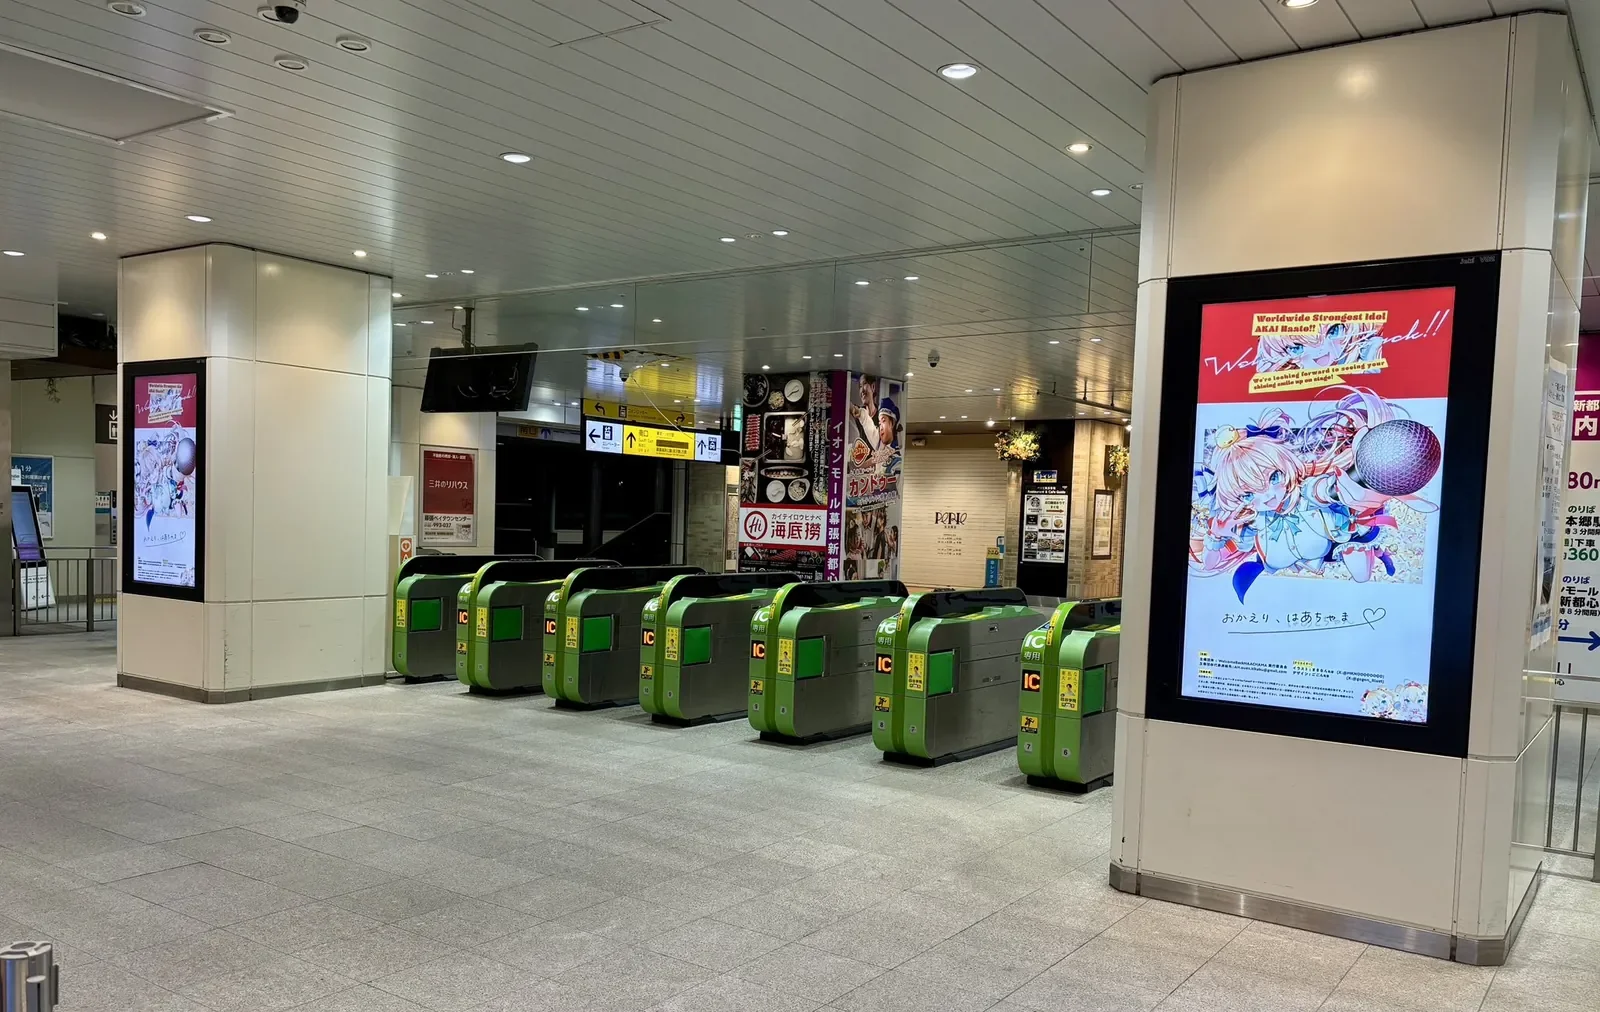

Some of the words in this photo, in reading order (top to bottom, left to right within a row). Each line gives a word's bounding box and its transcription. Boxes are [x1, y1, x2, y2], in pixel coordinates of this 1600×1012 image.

[1256, 314, 1310, 322] Worldwide
[1312, 312, 1363, 322] Strongest
[1365, 312, 1386, 320] Idol
[1280, 324, 1316, 332] Haato!!
[1253, 376, 1272, 384] We're
[1273, 372, 1300, 380] looking
[1301, 368, 1330, 376] forward
[1341, 362, 1366, 372] seeing
[1367, 361, 1386, 370] your
[1254, 382, 1276, 390] shining
[1314, 374, 1334, 382] stage!
[1574, 400, 1600, 412] 新都
[429, 480, 468, 490] 三井のリハウス
[850, 474, 897, 498] カンドゥー
[828, 421, 843, 582] イオンモール幕張新都心
[1568, 505, 1596, 514] のりば
[1562, 576, 1590, 584] のりば
[460, 584, 470, 593] IC
[547, 592, 560, 602] IC
[1560, 596, 1600, 608] 新都心
[644, 600, 658, 612] IC
[459, 611, 468, 624] IC
[754, 610, 770, 622] IC
[546, 620, 556, 633] IC
[878, 622, 896, 634] IC
[644, 631, 654, 644] IC
[1025, 634, 1046, 648] IC
[753, 643, 765, 658] IC
[1024, 652, 1040, 660] 専用
[878, 656, 892, 672] IC
[1024, 672, 1040, 690] IC
